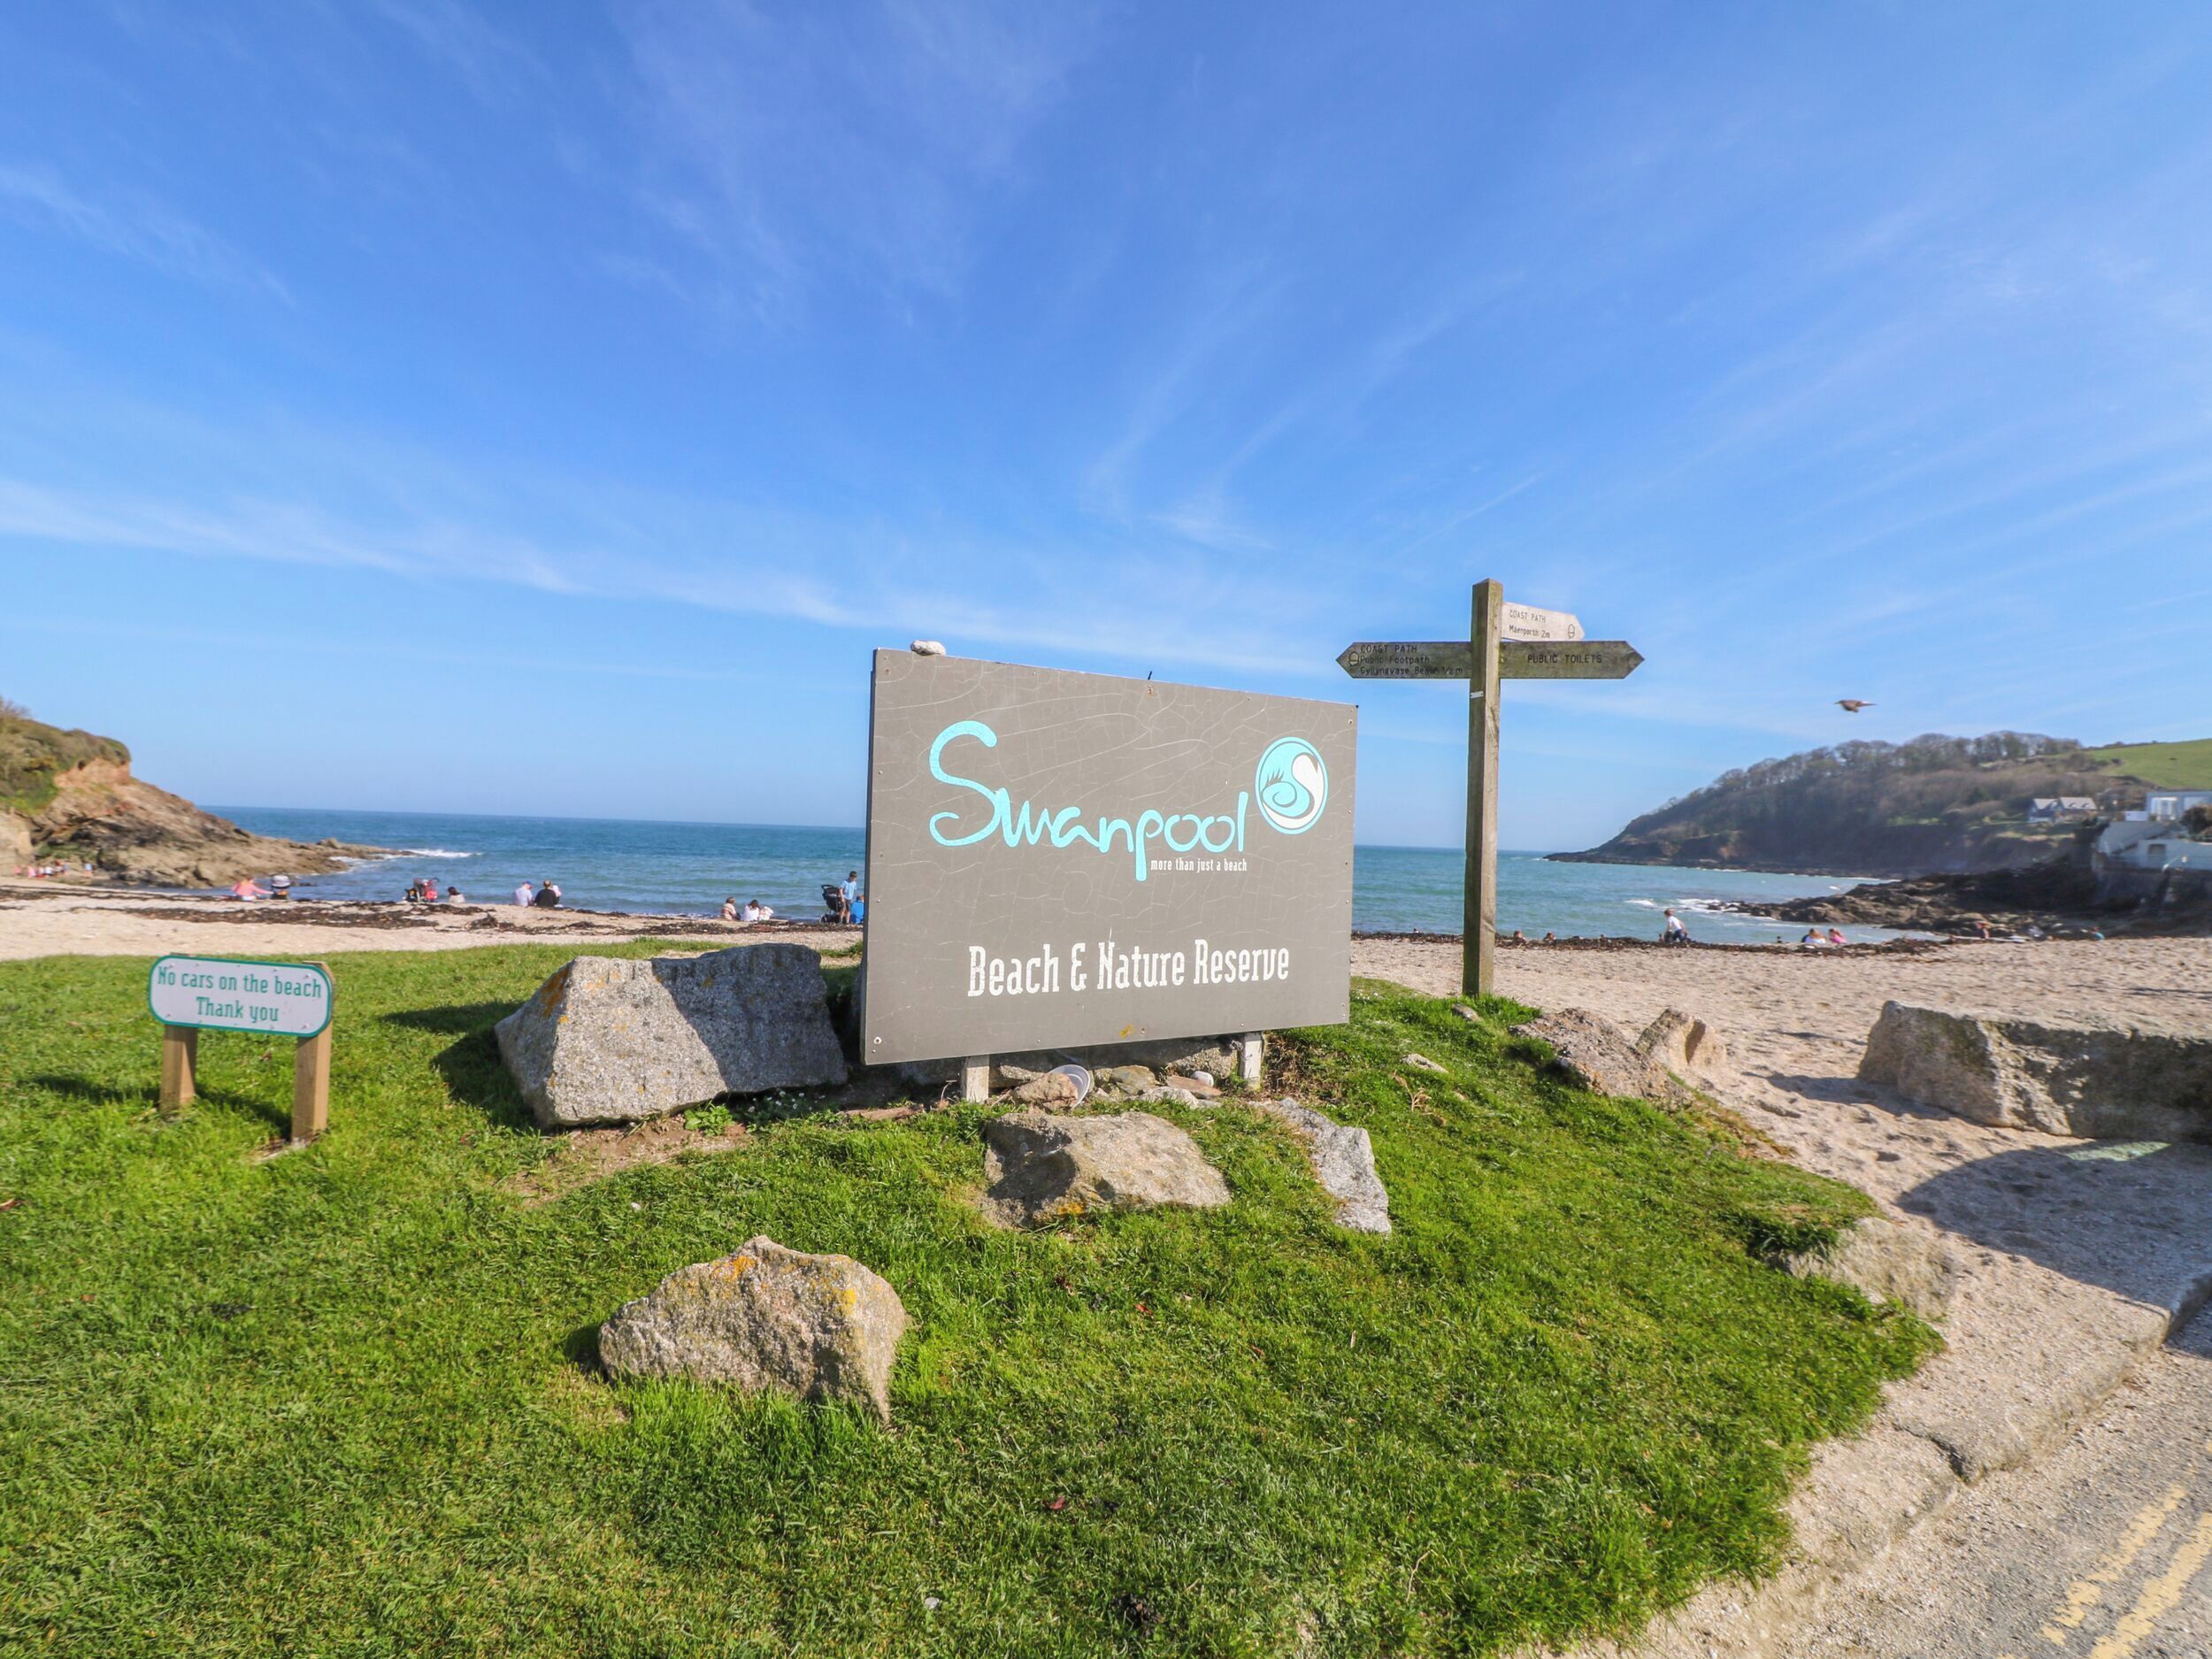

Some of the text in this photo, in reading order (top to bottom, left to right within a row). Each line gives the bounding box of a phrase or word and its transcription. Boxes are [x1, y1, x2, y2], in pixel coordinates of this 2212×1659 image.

[1509, 610, 1547, 623] COAST PATH
[1360, 644, 1417, 653] COAST PATH
[1389, 656, 1430, 665] Footpath
[1527, 655, 1602, 664] PUBLIC TOILETS
[928, 720, 1249, 881] Swanpool
[1150, 857, 1247, 873] more than just a beach
[967, 939, 1290, 997] Beach & Nature Reserve
[157, 966, 321, 998] No cars on the beach
[196, 996, 280, 1024] Thank you
